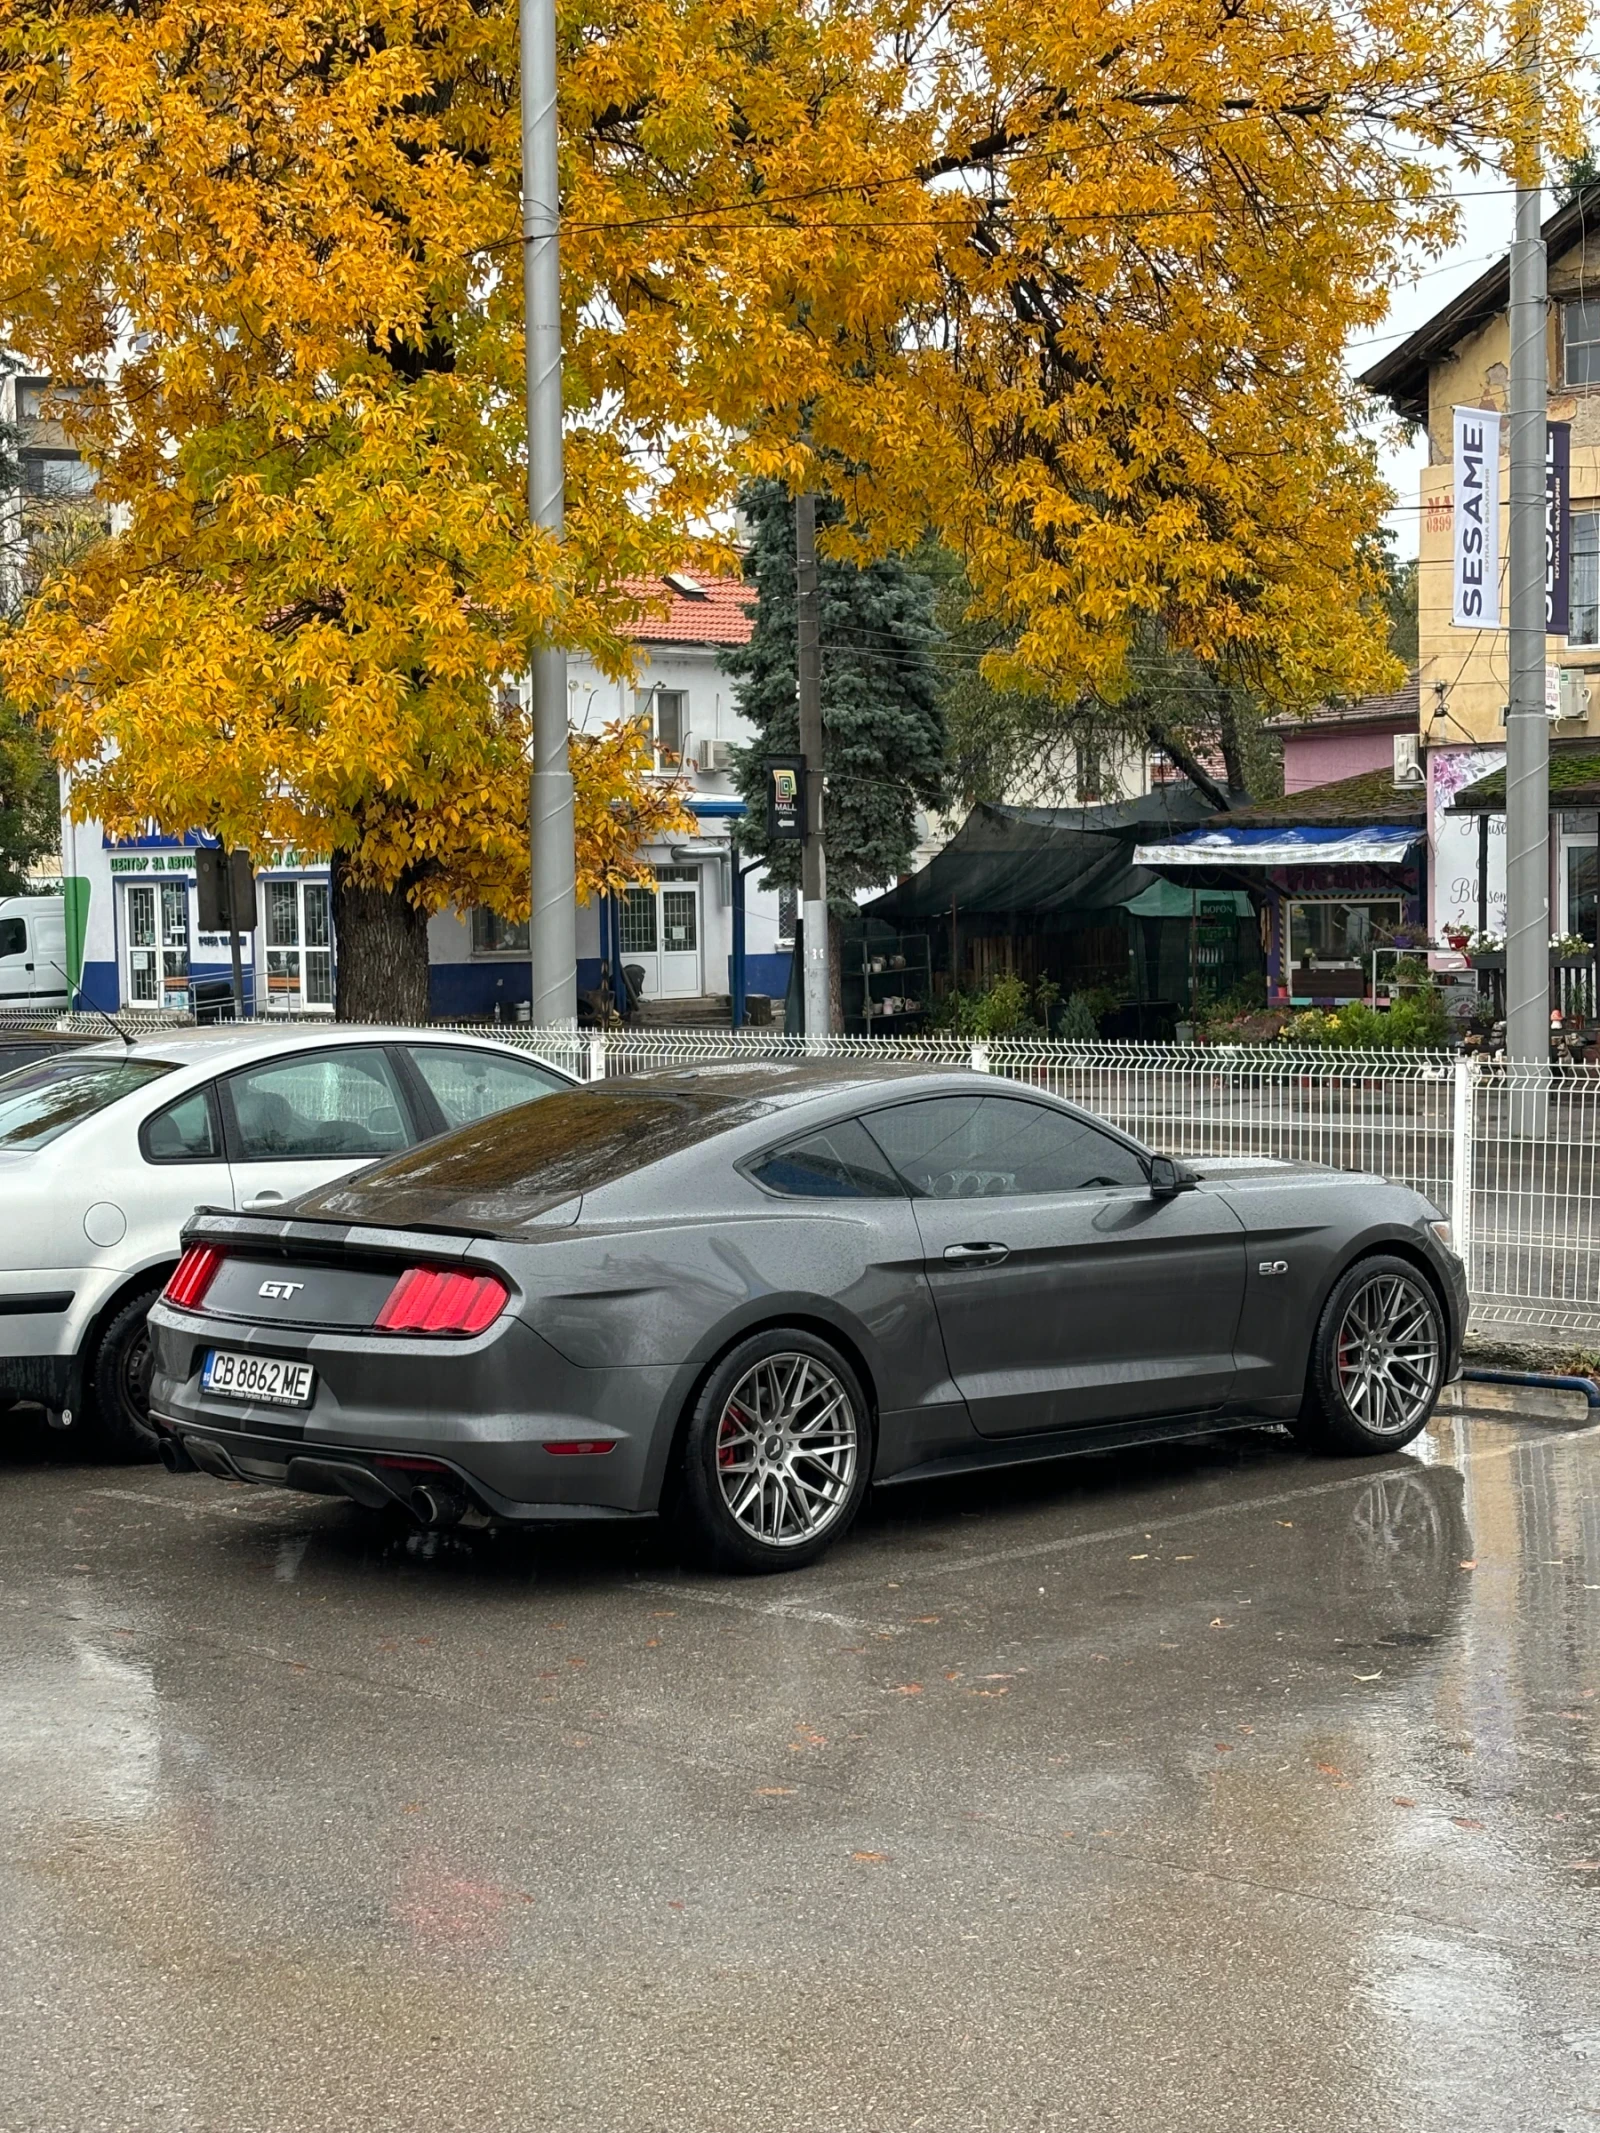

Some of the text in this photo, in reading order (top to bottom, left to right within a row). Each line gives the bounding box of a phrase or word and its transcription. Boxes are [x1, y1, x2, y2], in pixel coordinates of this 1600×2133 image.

[775, 803, 797, 811] MALL
[110, 857, 148, 872] ЦЕНТЪР
[152, 856, 165, 871] ЗА
[258, 1280, 305, 1300] GT
